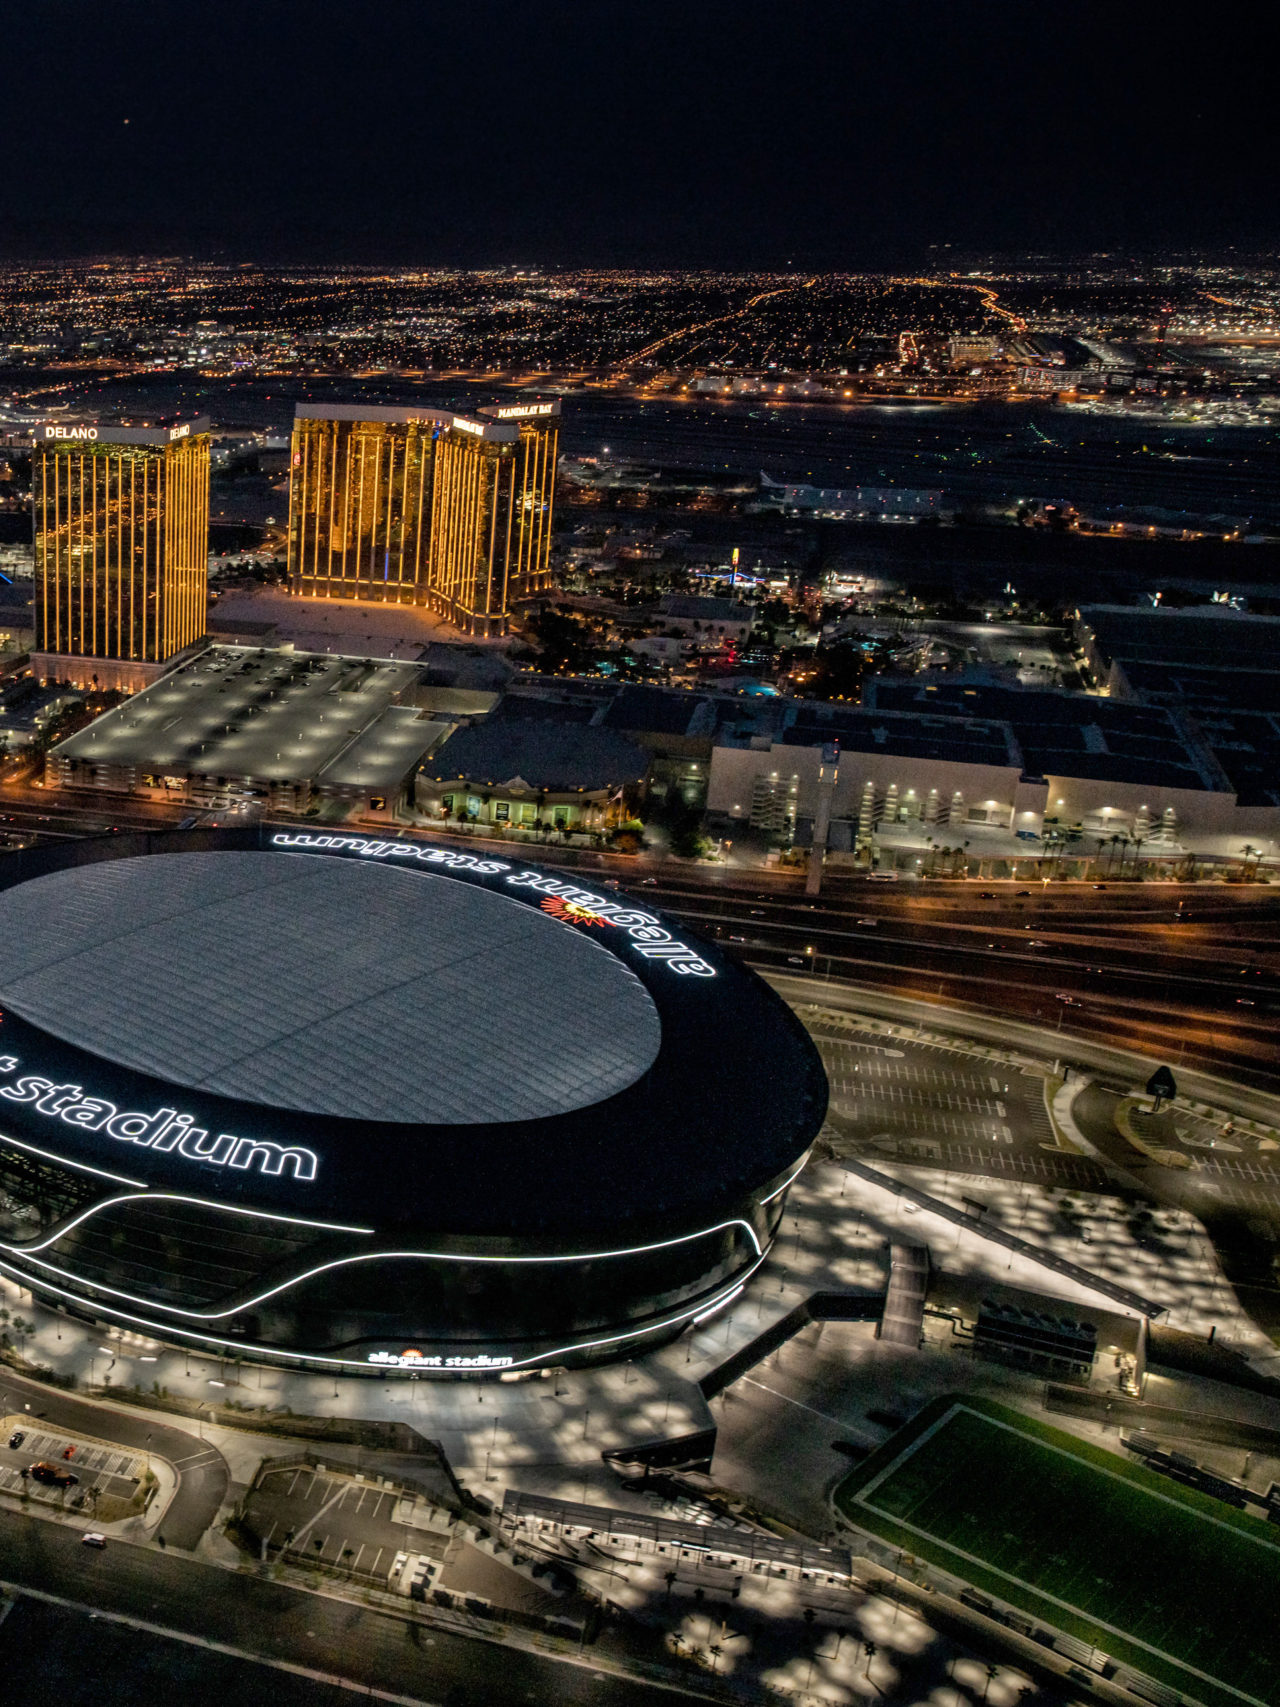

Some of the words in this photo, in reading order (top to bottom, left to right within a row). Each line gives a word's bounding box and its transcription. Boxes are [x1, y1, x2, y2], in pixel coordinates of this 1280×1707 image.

[497, 405, 539, 419] MANDALAY
[539, 403, 554, 414] BAY
[45, 426, 98, 440] DELANO
[272, 833, 513, 875] stadium
[506, 869, 718, 978] allegiant
[368, 1351, 442, 1367] allegiant
[445, 1354, 513, 1367] stadium
